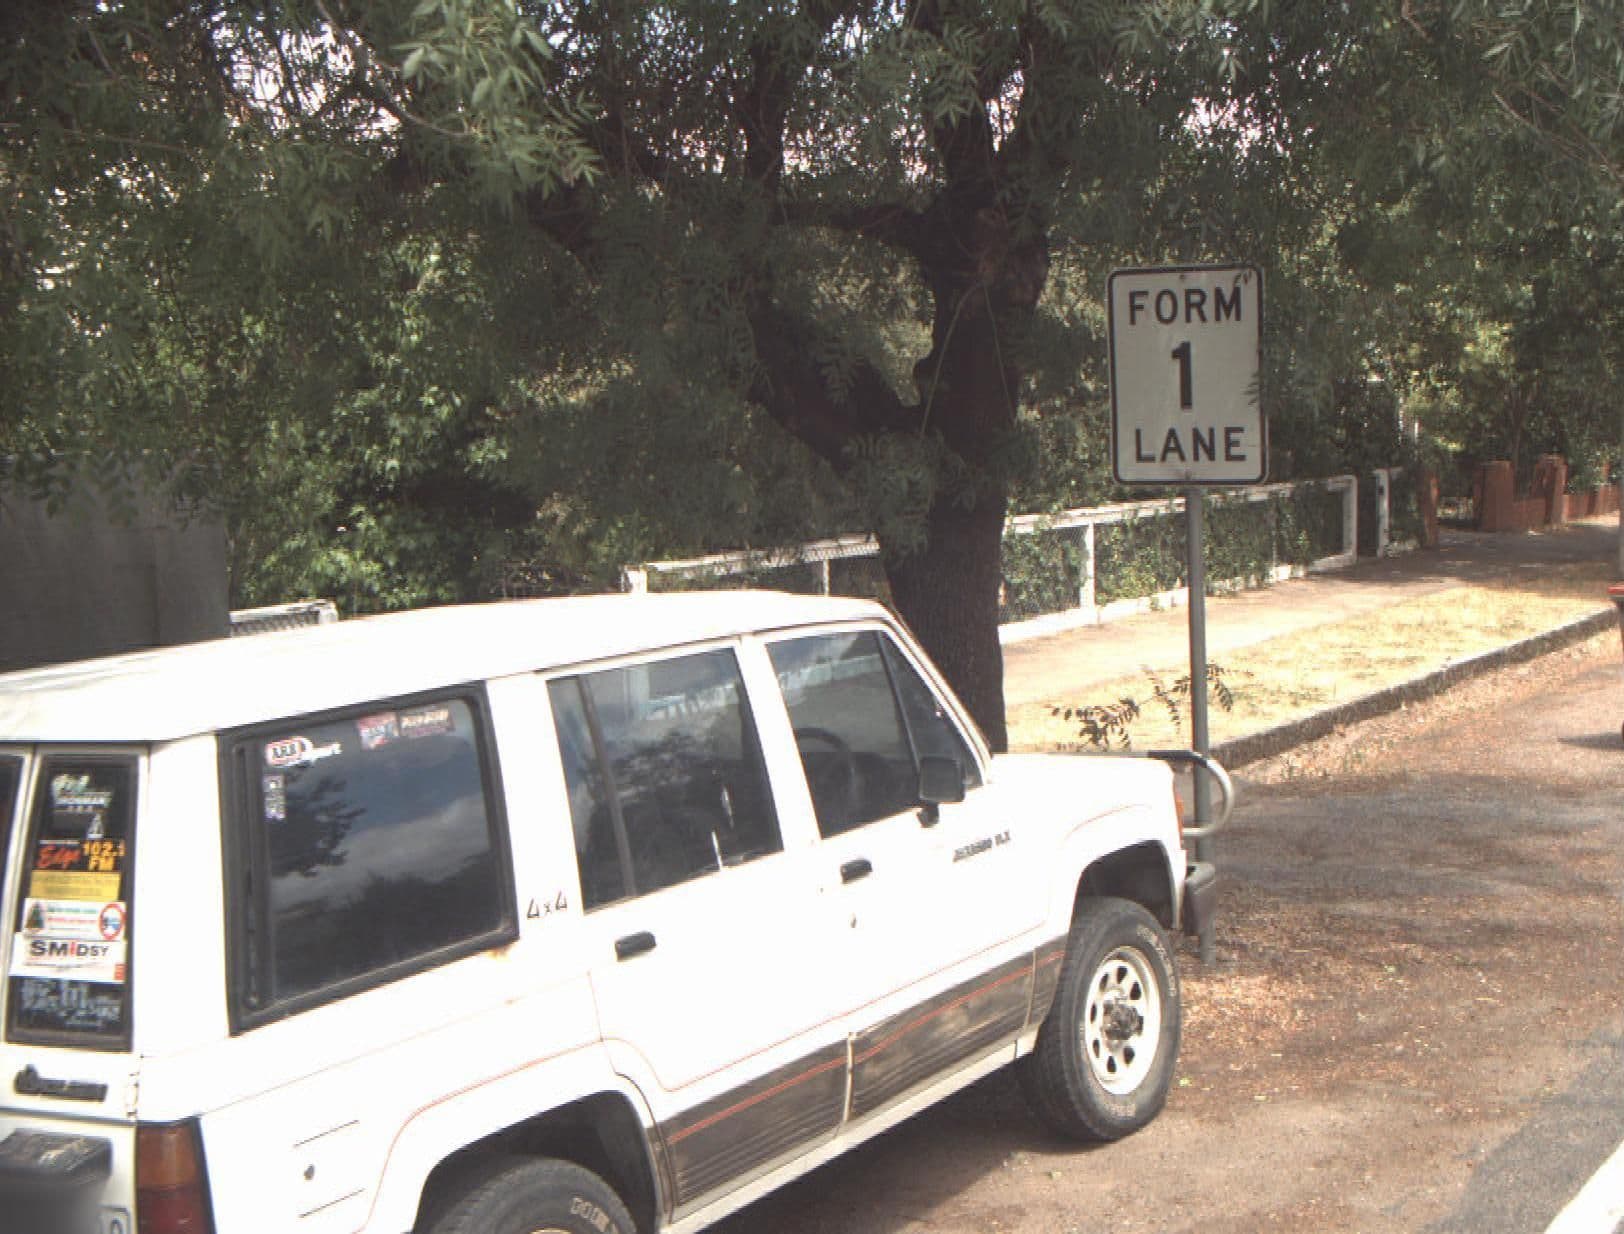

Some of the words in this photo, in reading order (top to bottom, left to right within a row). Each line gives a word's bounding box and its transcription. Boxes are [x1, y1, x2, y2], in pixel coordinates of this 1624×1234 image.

[1128, 286, 1242, 325] FORM
[1171, 341, 1193, 410] 1
[1134, 427, 1247, 463] LANE
[88, 855, 115, 871] FM
[526, 890, 568, 919] 4x4
